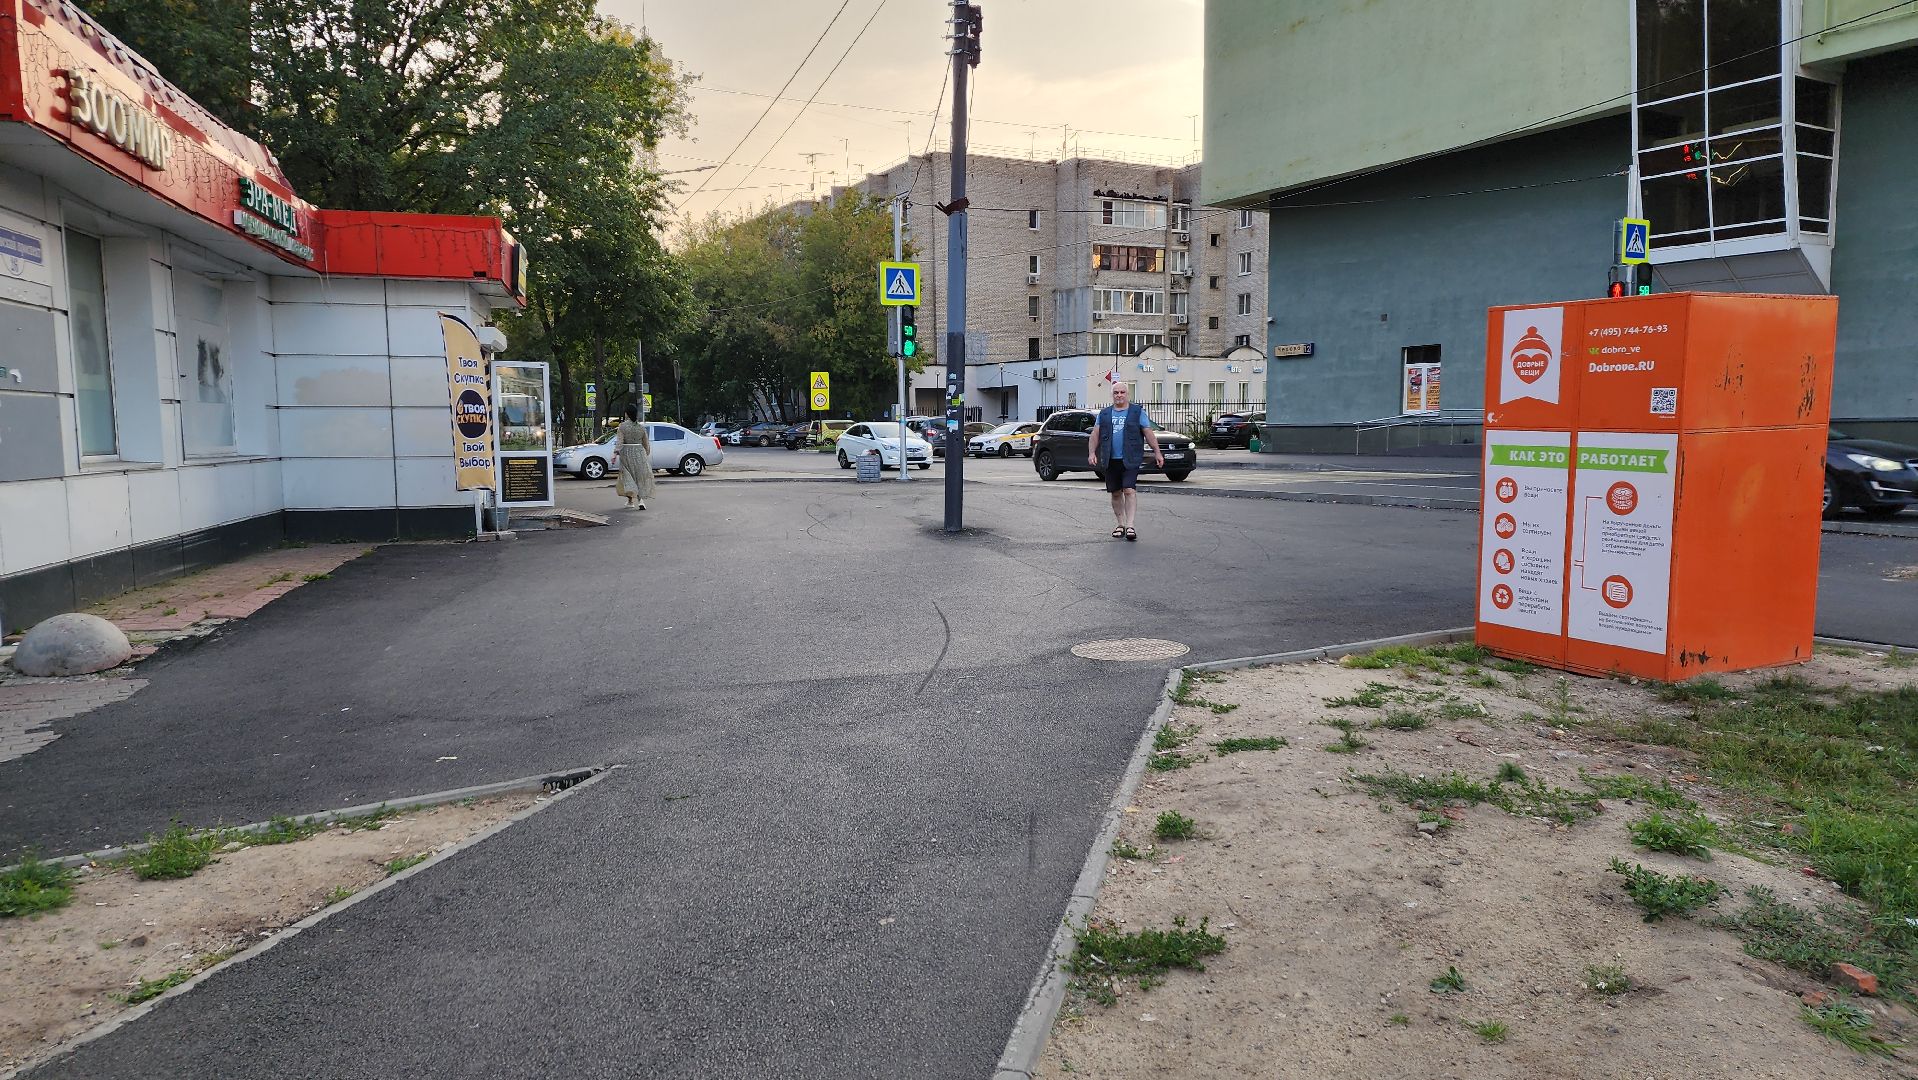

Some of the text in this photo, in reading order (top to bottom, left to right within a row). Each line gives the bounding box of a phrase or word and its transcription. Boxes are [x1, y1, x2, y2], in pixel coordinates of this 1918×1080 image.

[72, 69, 171, 170] ЗООМИР
[245, 178, 298, 237] ЭРА-МЕД
[1588, 324, 1668, 338] +7 (495) 744-76-93
[1601, 345, 1641, 355] dobro_ve
[458, 356, 478, 368] Твоя
[1516, 360, 1545, 369] ДОБРЫЕ
[1588, 360, 1655, 373] Dobrove.RU
[454, 373, 485, 386] Скупка
[463, 403, 486, 413] ТВОЯ
[457, 414, 487, 424] СКУПКА
[462, 441, 485, 452] Твой
[459, 457, 491, 469] Выбор
[1509, 450, 1657, 467] КАК ЭТО РАБОТАЕТ
